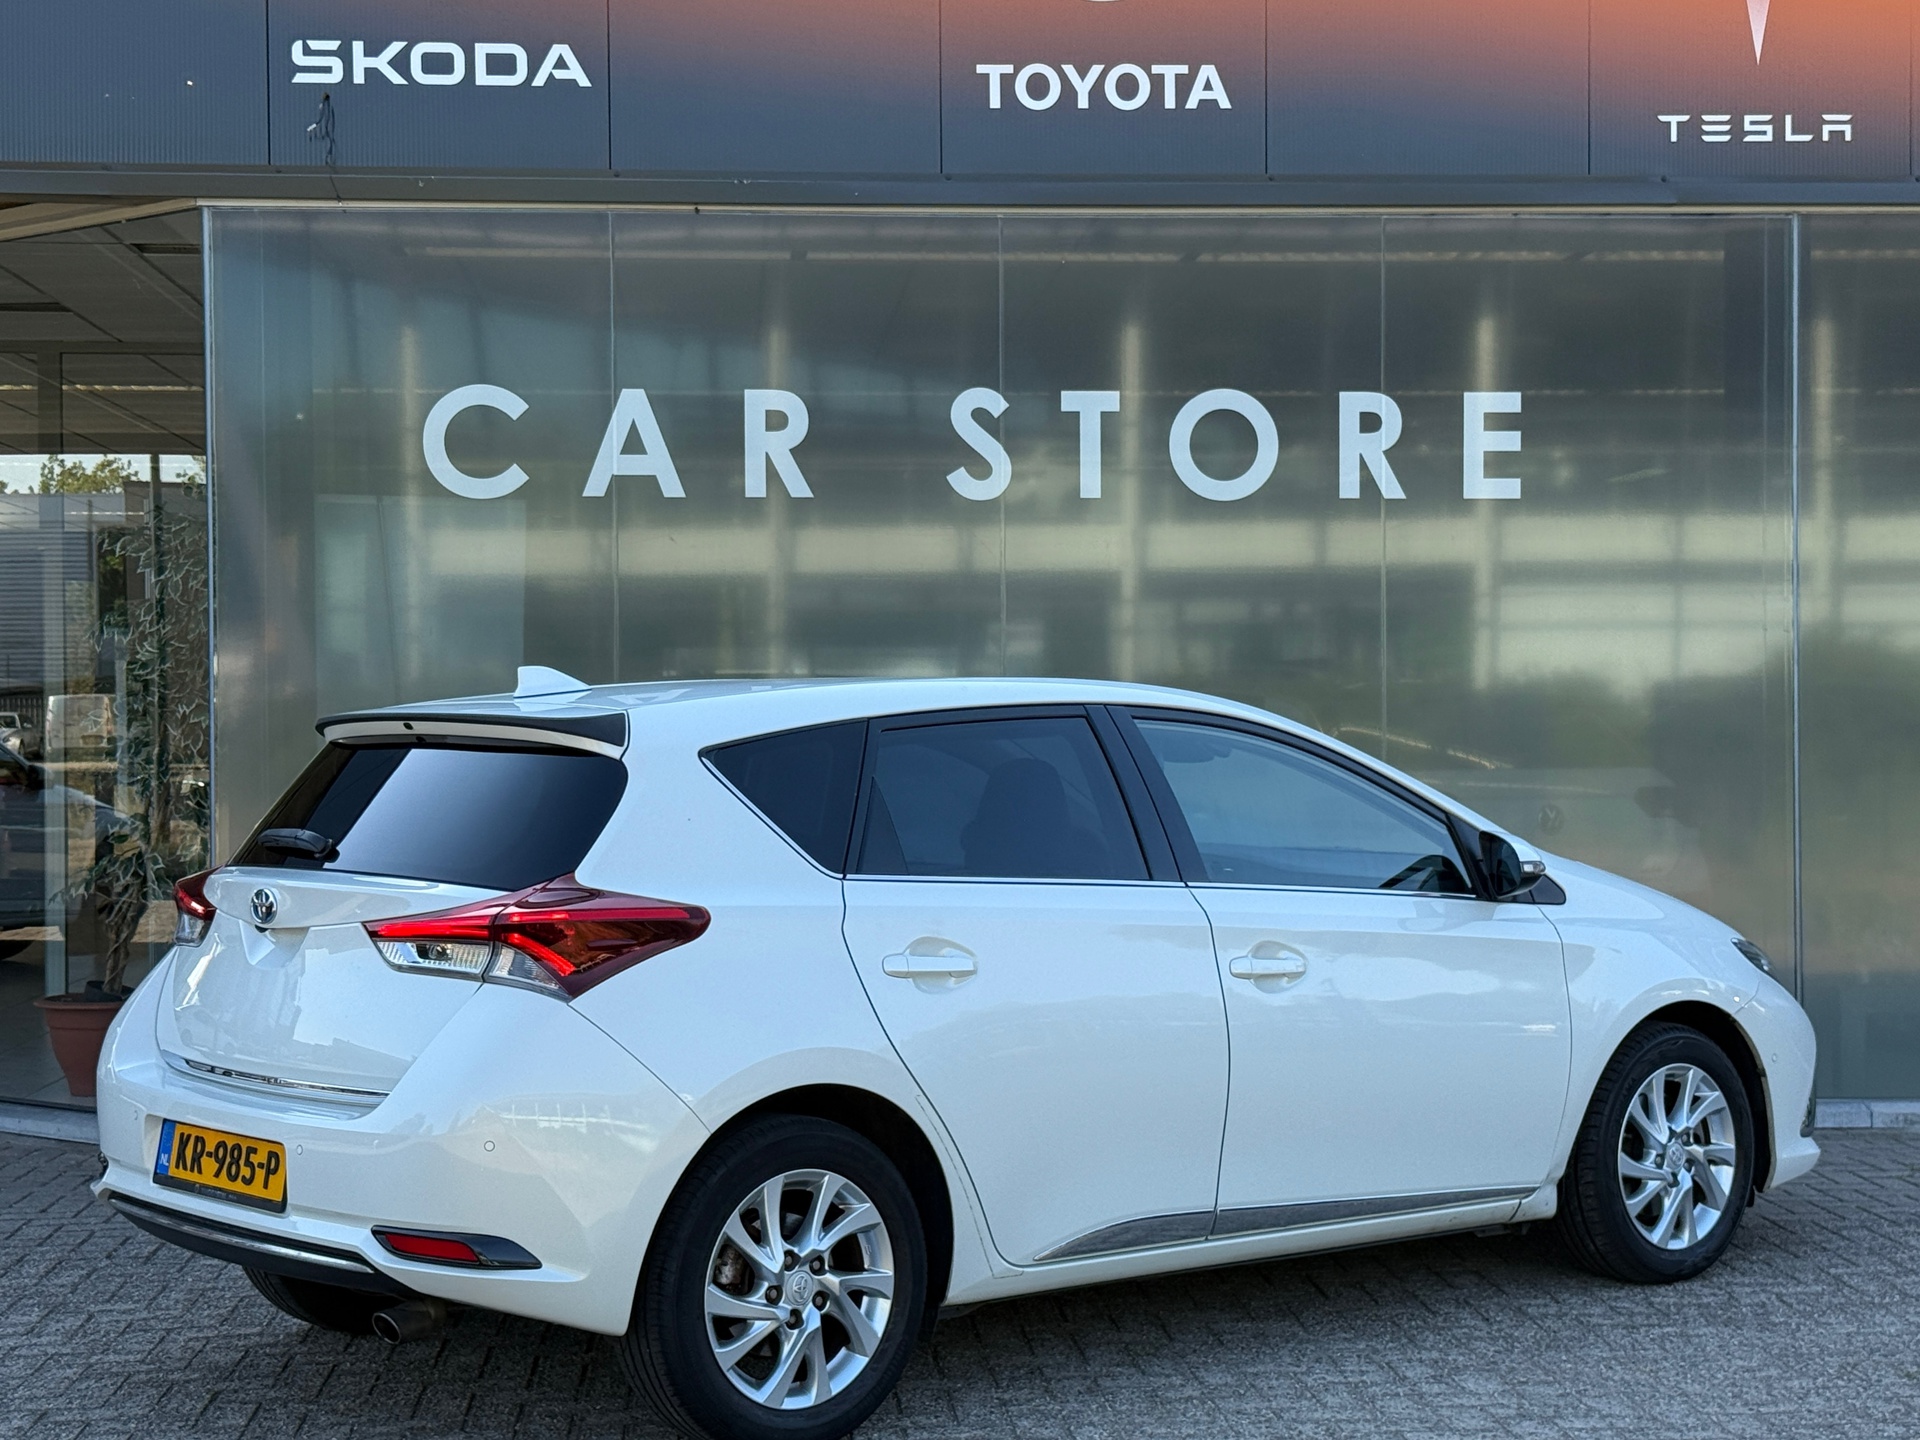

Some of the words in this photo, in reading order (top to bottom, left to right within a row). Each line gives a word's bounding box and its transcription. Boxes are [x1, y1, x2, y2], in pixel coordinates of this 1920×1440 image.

[290, 39, 592, 87] SKODA
[975, 62, 1232, 111] TOYOTA
[1657, 113, 1854, 142] TESLA
[422, 383, 815, 500] CAR
[946, 387, 1522, 502] STORE
[160, 1153, 170, 1166] NL
[174, 1131, 281, 1190] KR-985-P
